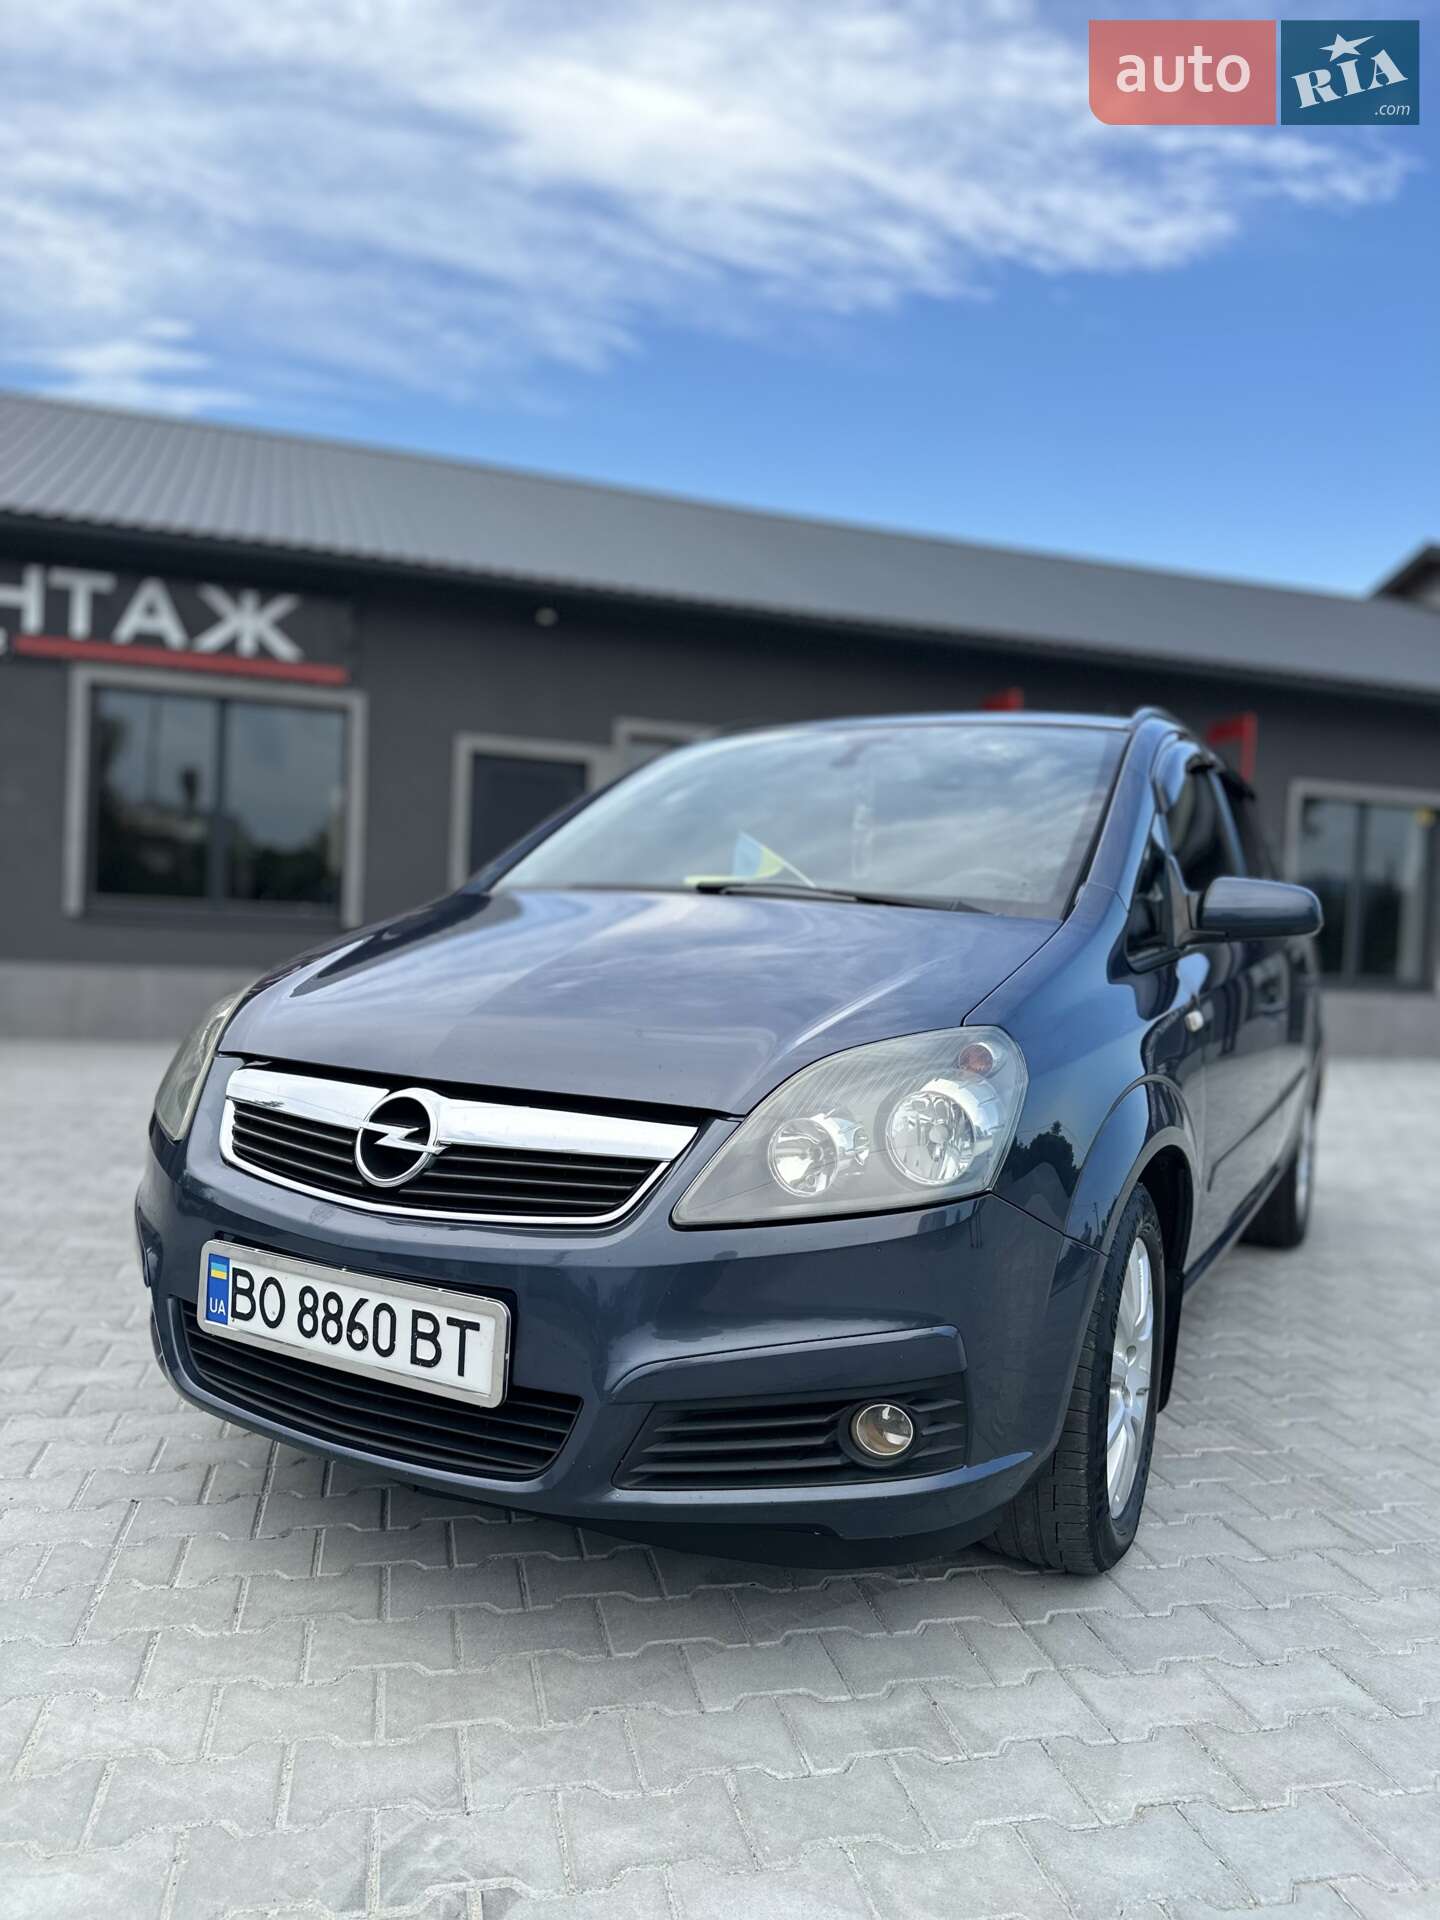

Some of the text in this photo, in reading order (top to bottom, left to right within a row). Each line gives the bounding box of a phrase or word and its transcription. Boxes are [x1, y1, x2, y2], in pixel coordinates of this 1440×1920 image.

[208, 1298, 226, 1316] UA
[230, 1267, 480, 1377] BO 8860 BT
